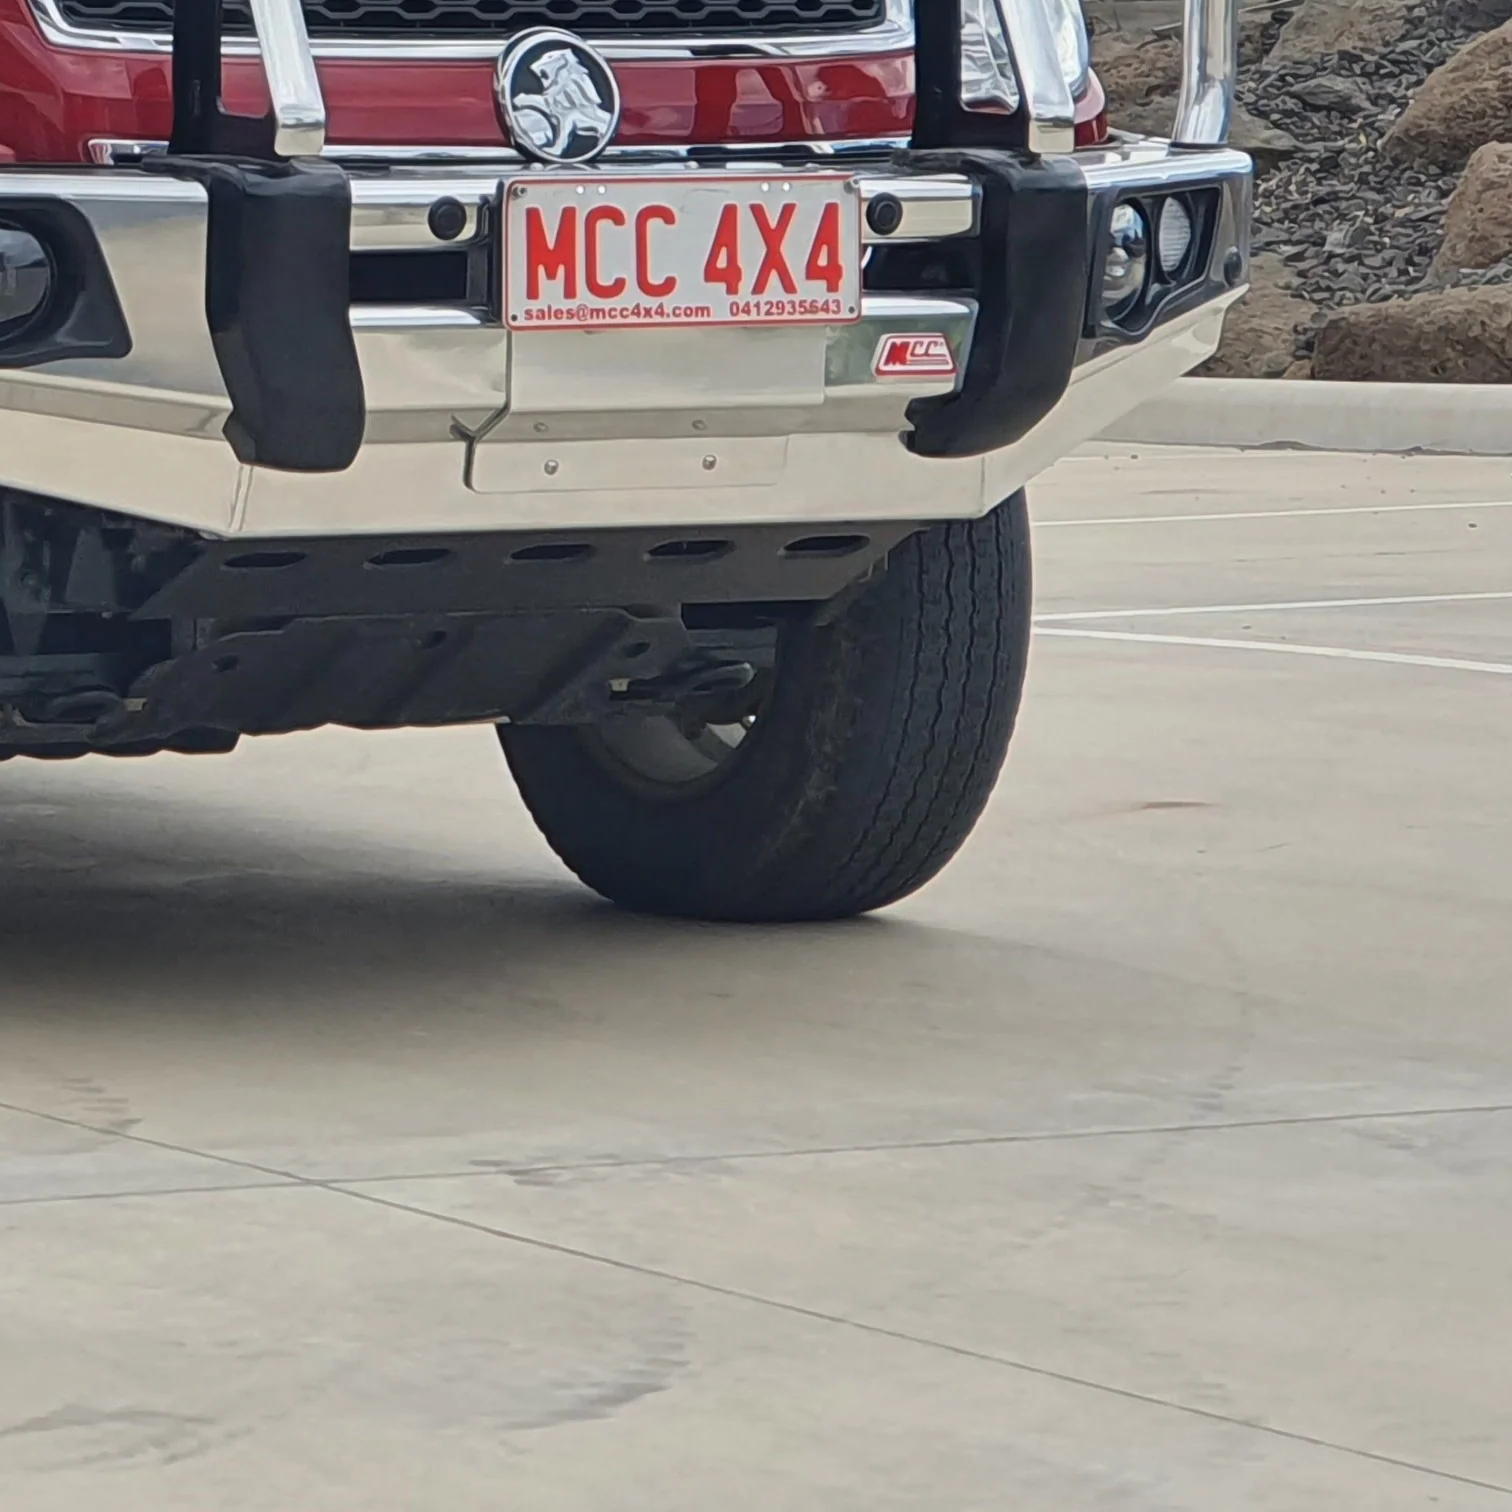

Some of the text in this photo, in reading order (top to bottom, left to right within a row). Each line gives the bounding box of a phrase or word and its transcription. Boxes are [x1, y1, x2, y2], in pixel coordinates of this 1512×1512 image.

[525, 202, 844, 300] MCC 4X4
[524, 299, 842, 323] sales@mcc4x4.com 0412935643
[884, 340, 947, 366] MCC
